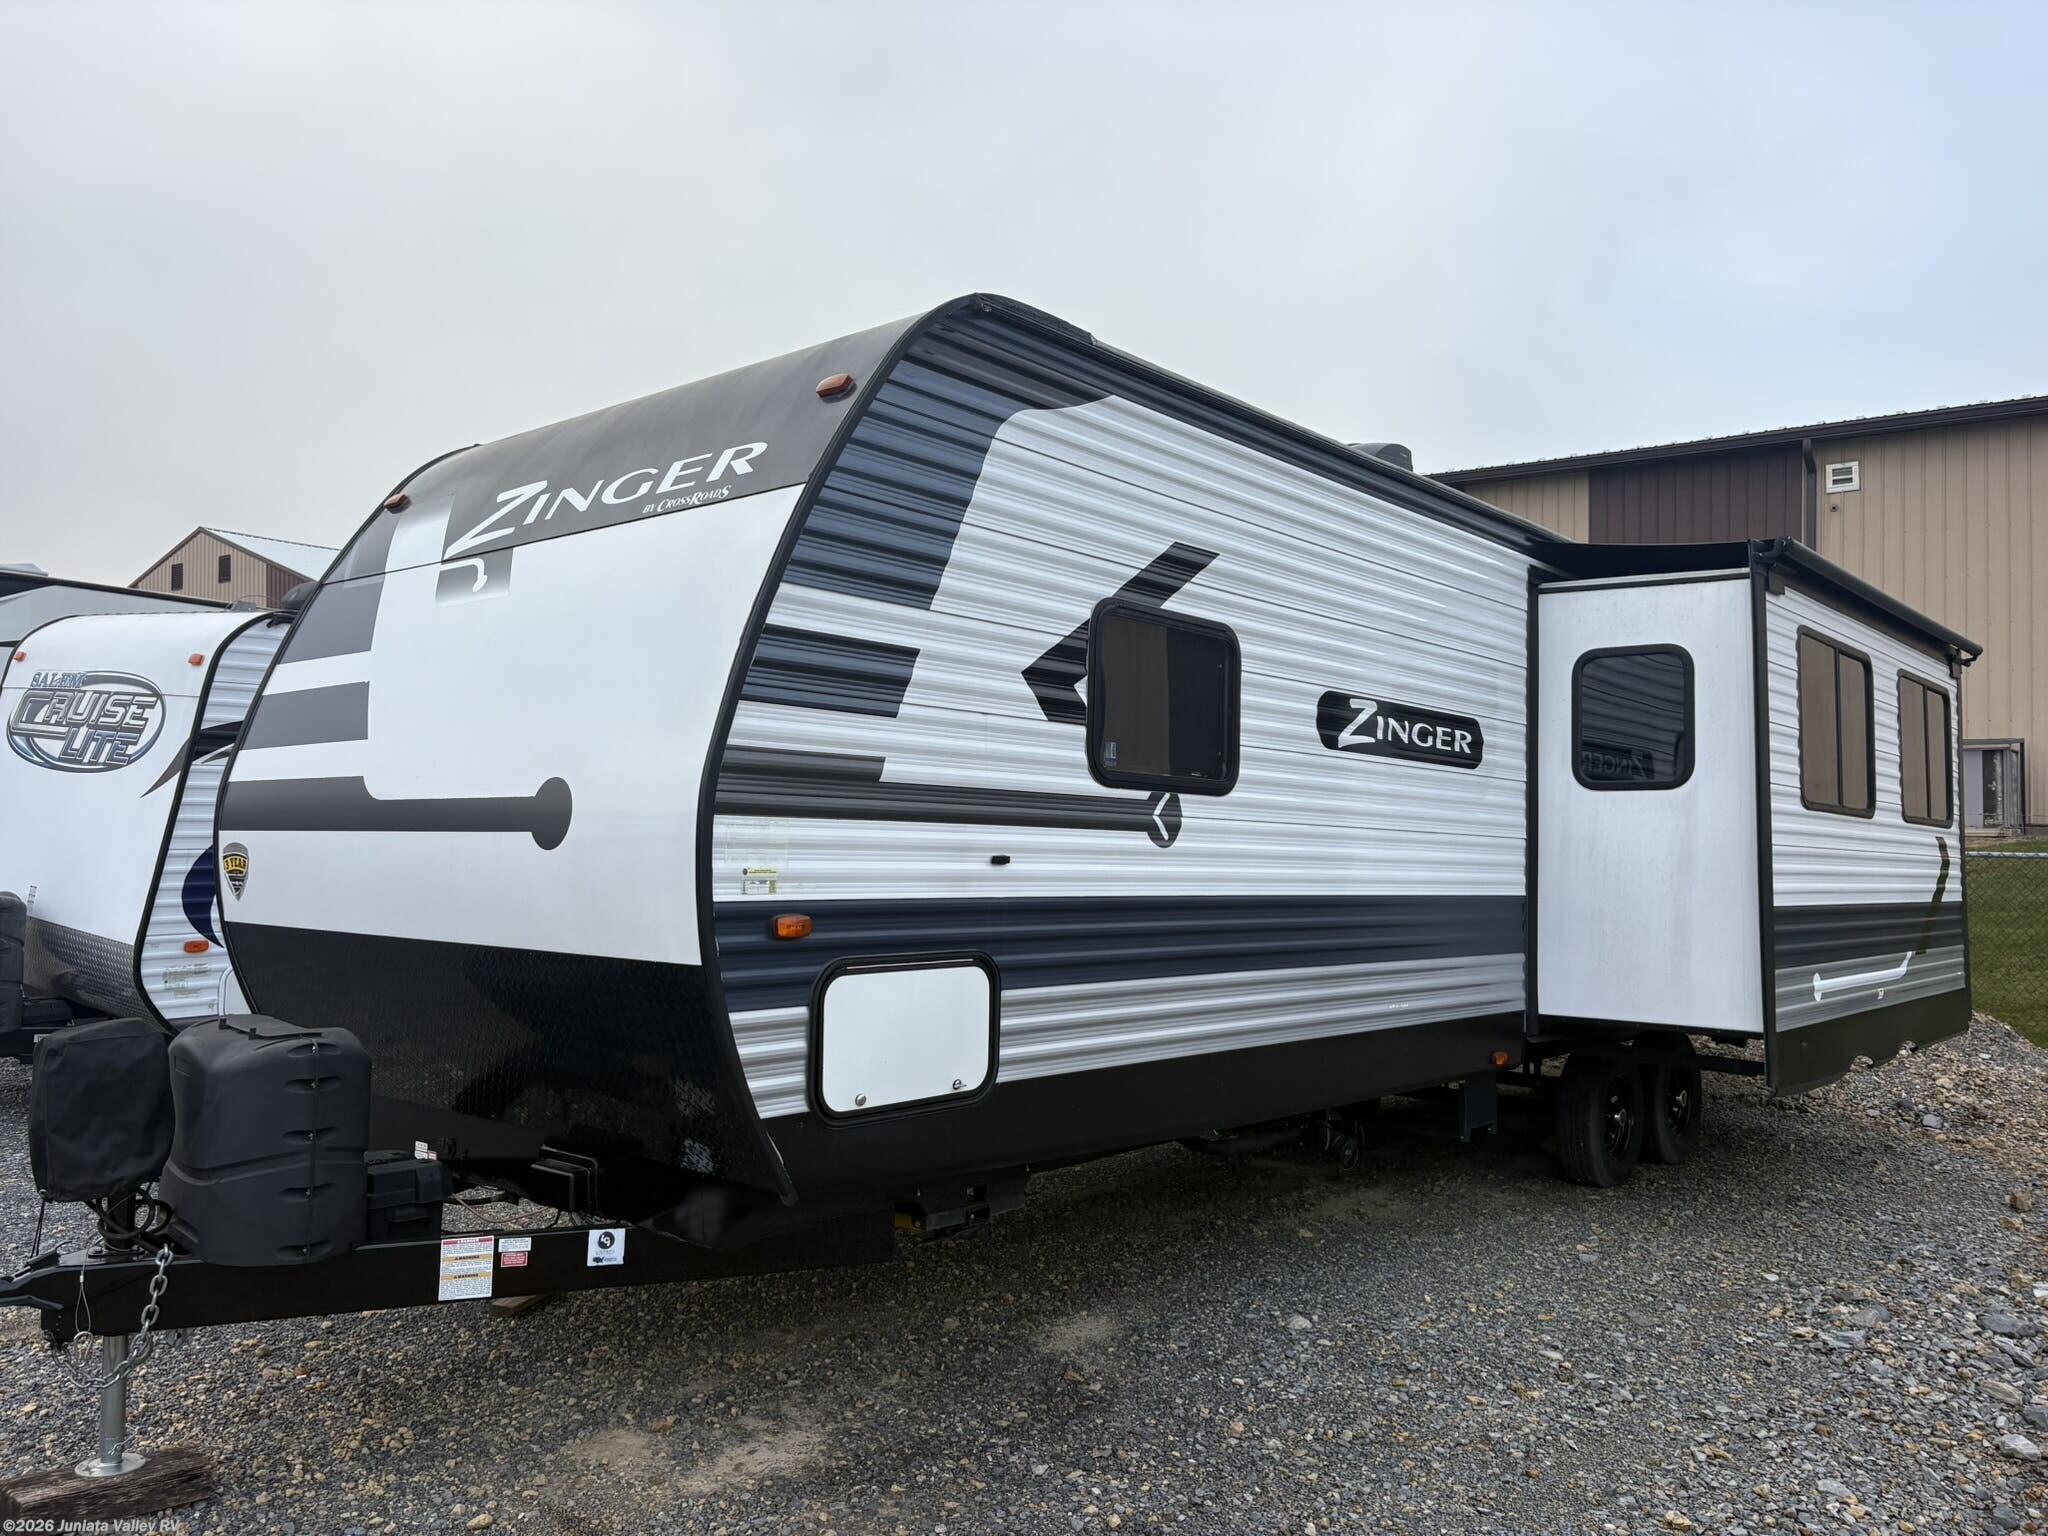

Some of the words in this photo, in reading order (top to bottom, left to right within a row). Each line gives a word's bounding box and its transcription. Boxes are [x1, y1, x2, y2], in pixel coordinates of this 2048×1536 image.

[443, 442, 768, 560] ZINGER
[642, 503, 656, 514] BY
[30, 671, 87, 689] SALEM
[10, 689, 159, 740] CRUISE
[1338, 698, 1473, 754] ZINGER
[58, 727, 141, 766] LITE
